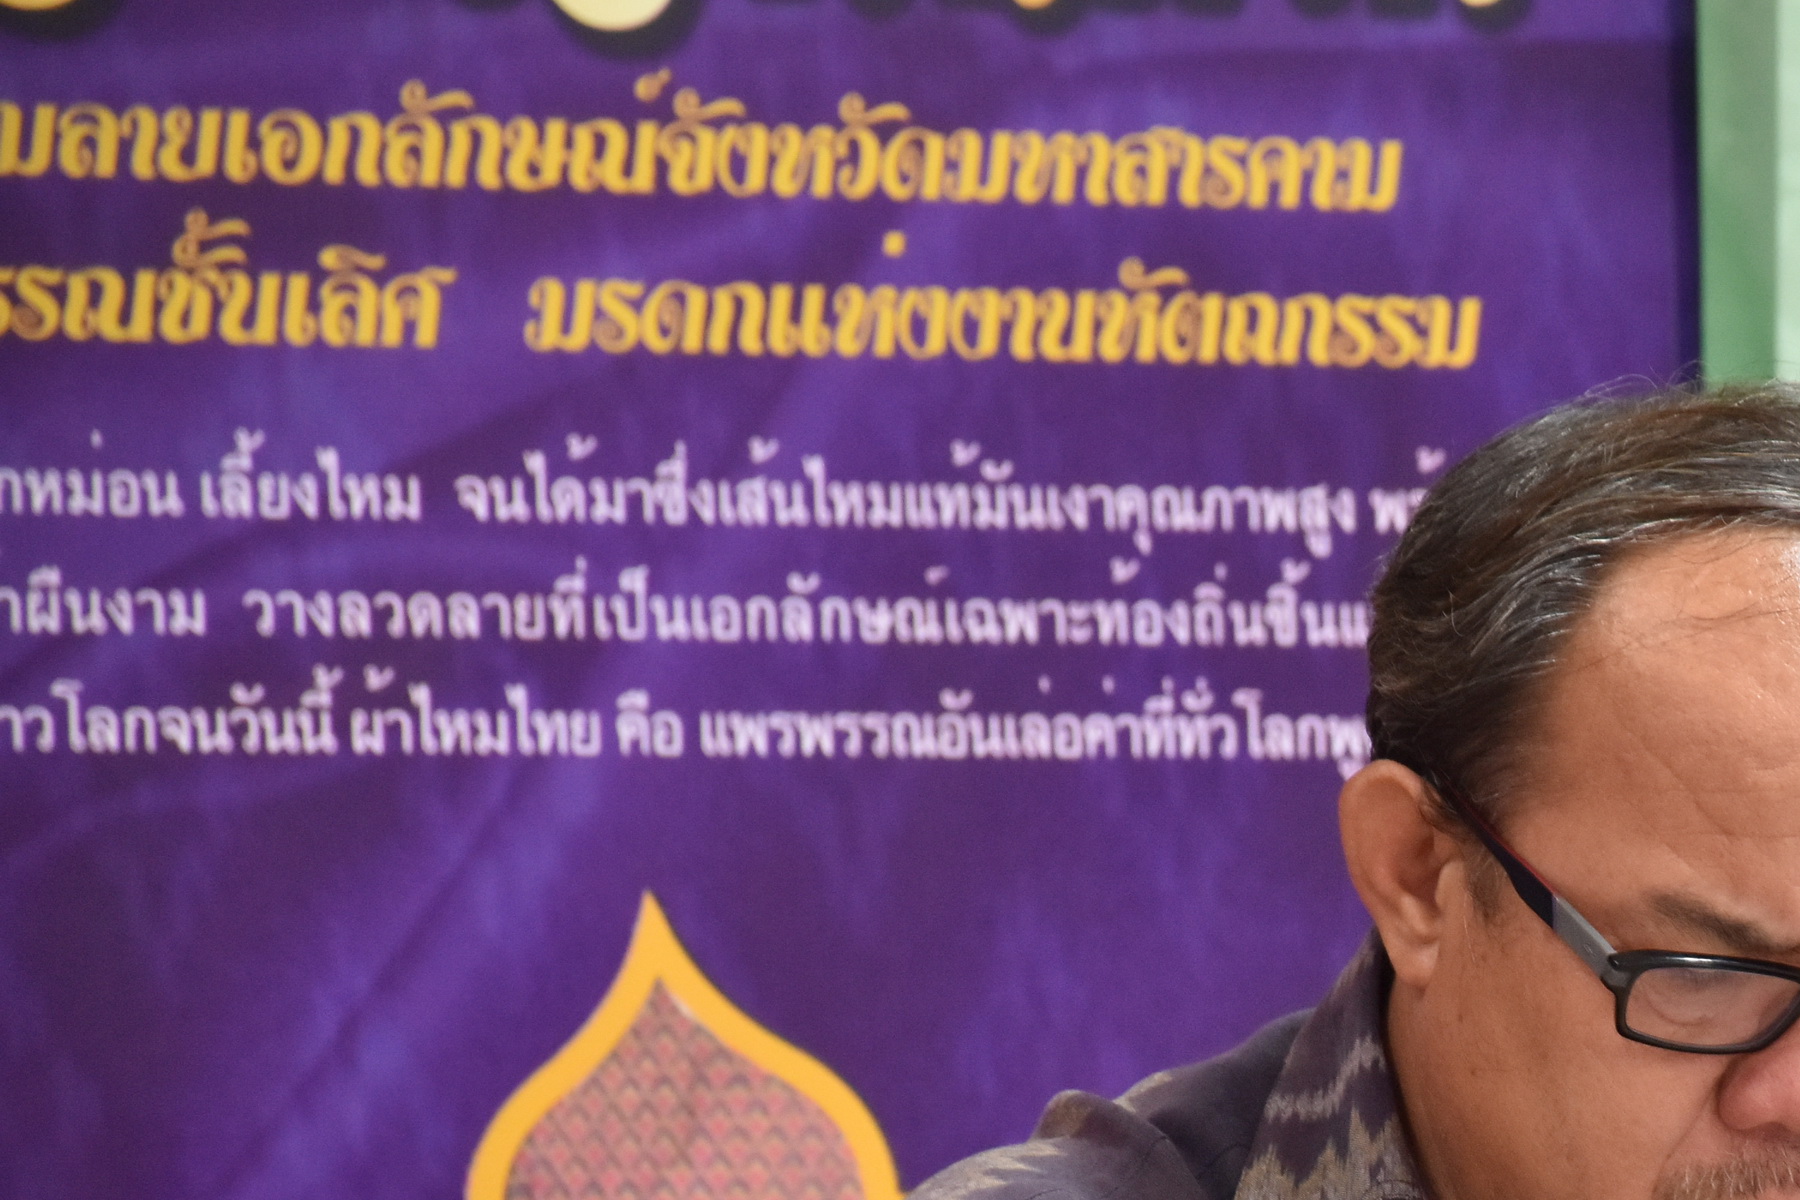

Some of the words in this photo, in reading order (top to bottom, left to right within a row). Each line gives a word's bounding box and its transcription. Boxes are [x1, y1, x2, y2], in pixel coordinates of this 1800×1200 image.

[0, 207, 460, 350] รณชั้นเลิศ
[523, 230, 1484, 370] มรดกแห่งงานหัตถกรรม
[200, 427, 422, 521] เลี้ยงไหม
[350, 664, 603, 758] ผ้าไหมไทย
[614, 688, 685, 758] คือ
